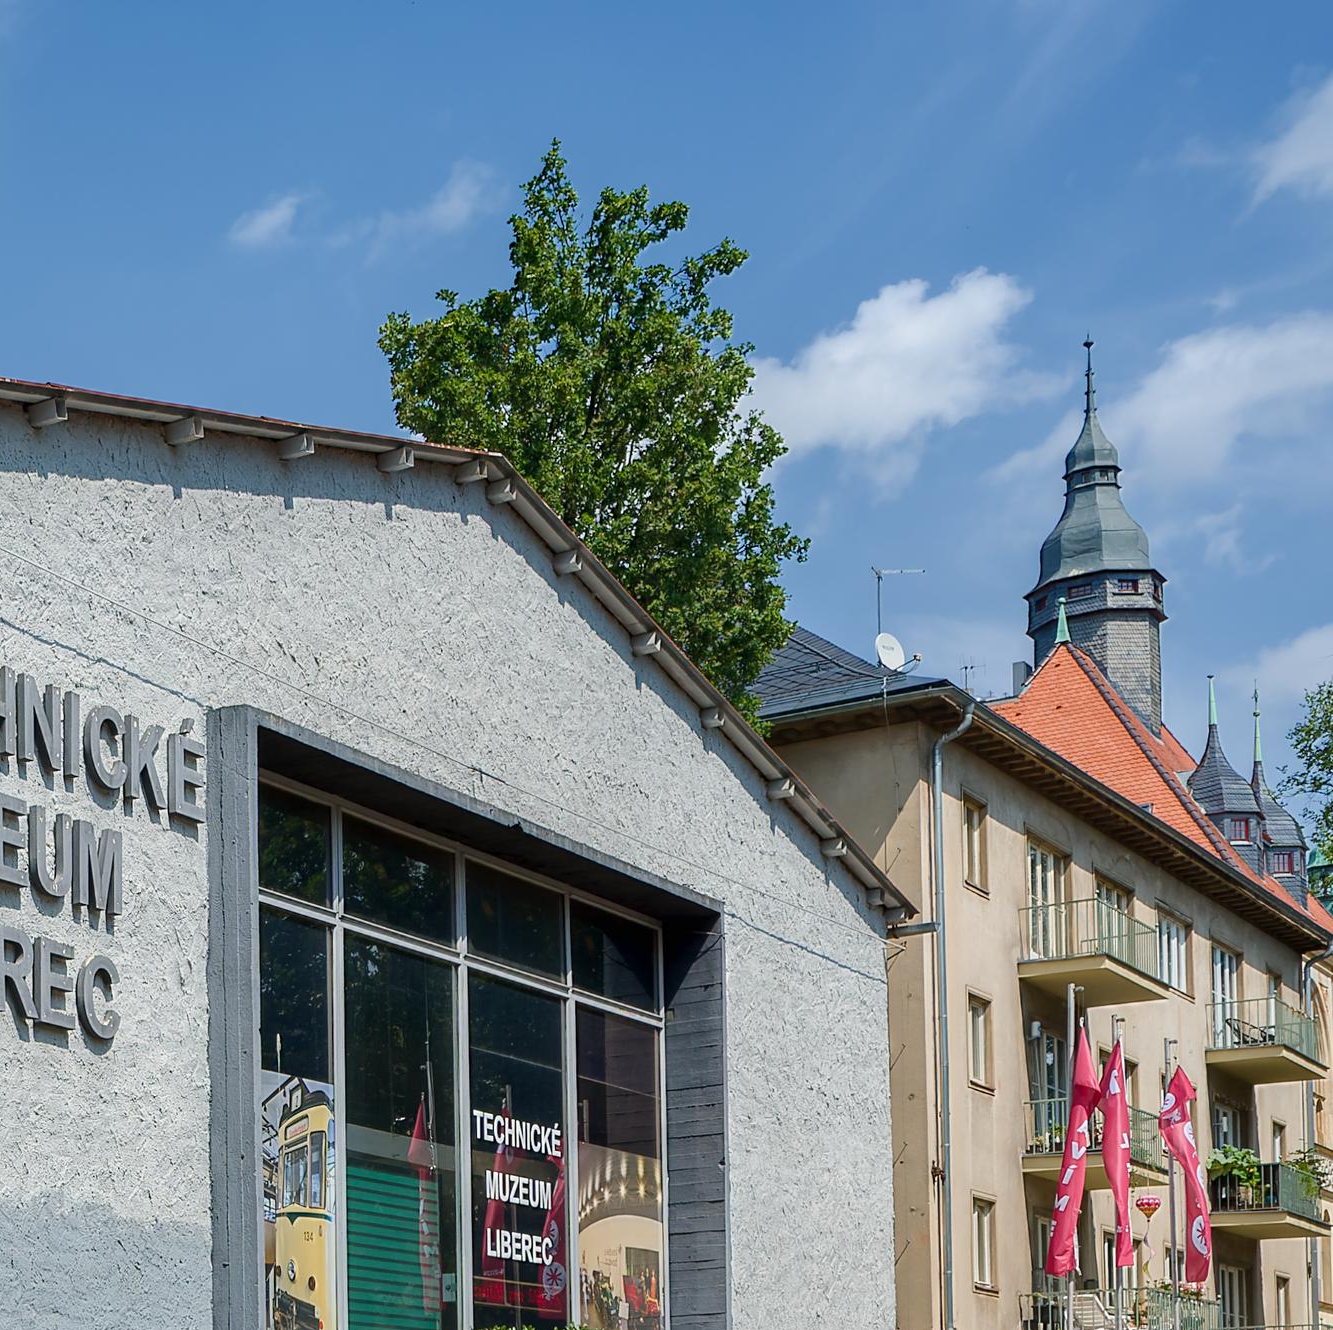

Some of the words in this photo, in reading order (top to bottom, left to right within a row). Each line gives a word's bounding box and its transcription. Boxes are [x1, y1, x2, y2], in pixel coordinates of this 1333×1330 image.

[472, 1109, 562, 1158] TECHNICKÉ
[485, 1169, 552, 1211] MUZEUM
[486, 1227, 553, 1267] LIBEREC
